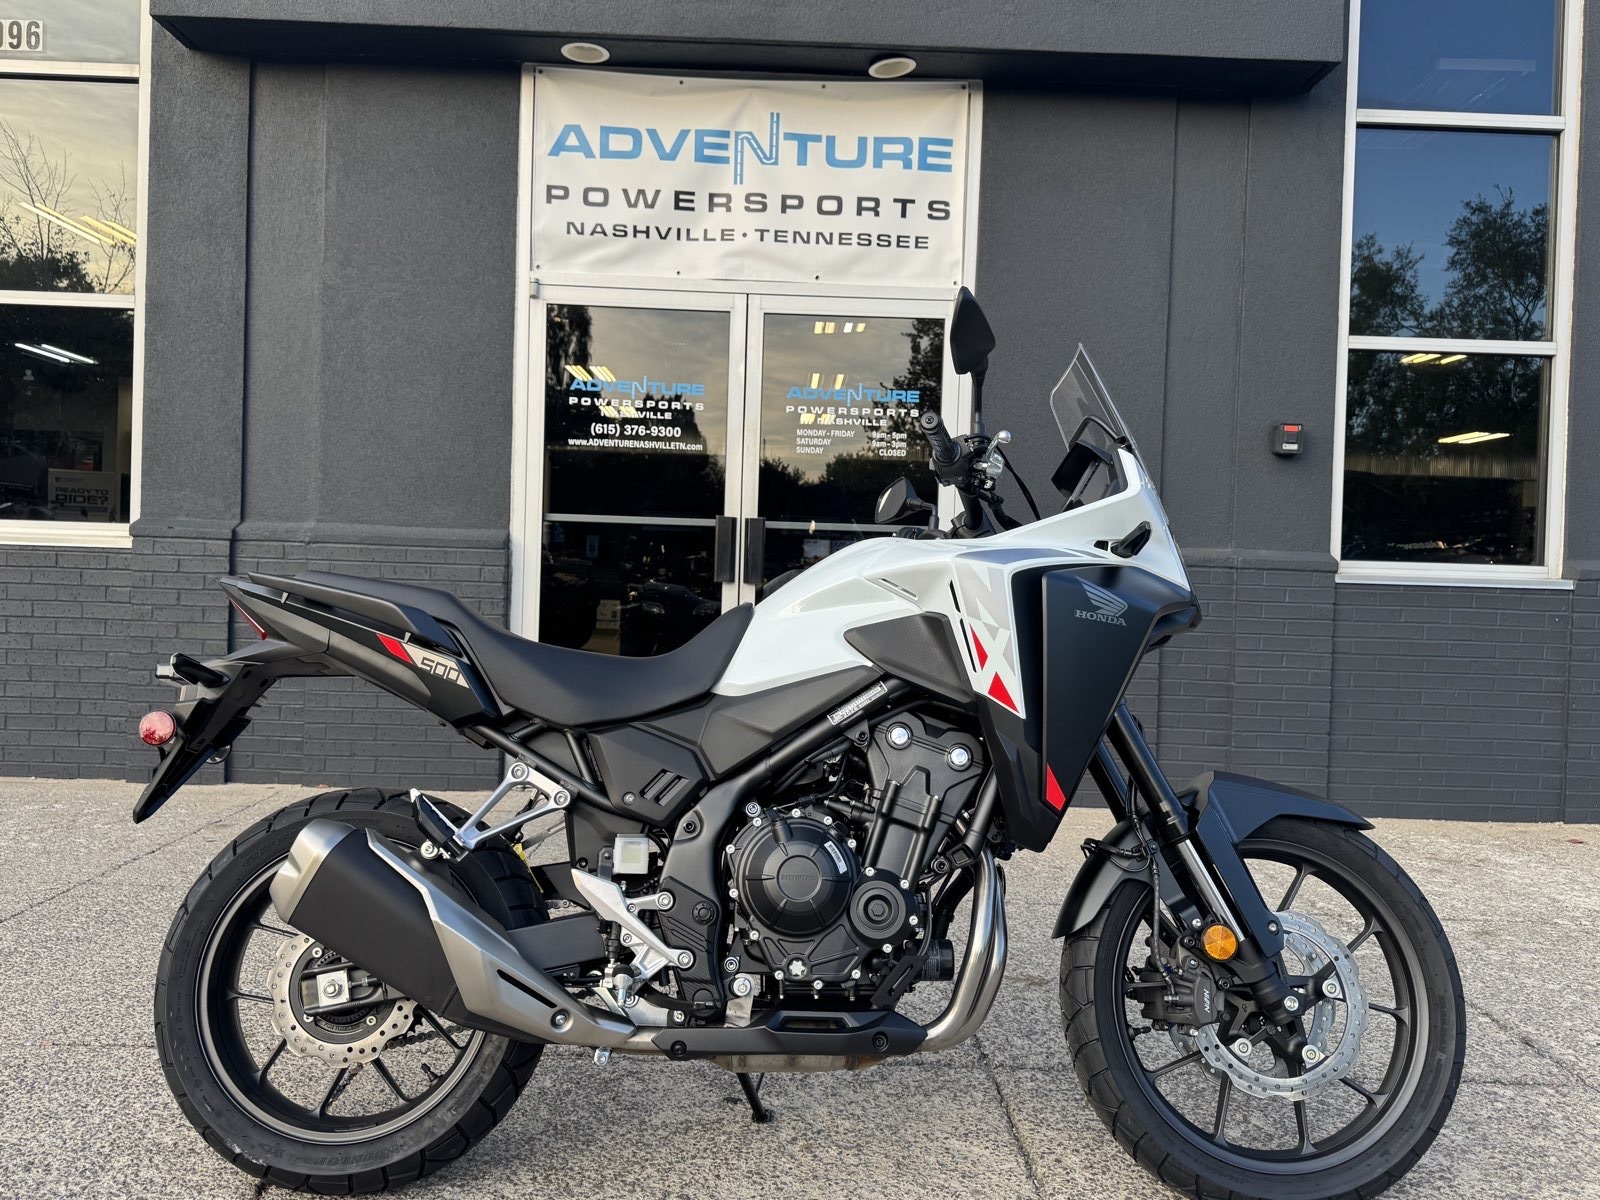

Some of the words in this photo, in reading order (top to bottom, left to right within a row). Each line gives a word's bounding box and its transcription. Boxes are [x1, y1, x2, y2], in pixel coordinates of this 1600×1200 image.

[0, 20, 41, 50] 96
[547, 112, 953, 185] ADVENTURE
[545, 184, 951, 221] POWERSPORTS
[569, 376, 705, 399] ADVENTURE
[786, 383, 921, 407] ADVENTURE
[568, 397, 705, 410] POWERSPORTS
[600, 410, 672, 419] SVILLE
[785, 406, 920, 418] POWERSPORTS
[590, 422, 621, 437] (615)
[623, 424, 682, 438] 376-9300
[568, 438, 703, 451] www.ADVENTURENASHVILLETN.com
[796, 437, 832, 446] SATURDAY
[795, 446, 824, 454] SUNDAY
[878, 448, 907, 457] CLOSED
[55, 487, 92, 495] READY
[94, 488, 109, 496] TO
[55, 493, 109, 506] RIDE?
[1074, 609, 1127, 627] HONDA
[420, 656, 461, 682] 500
